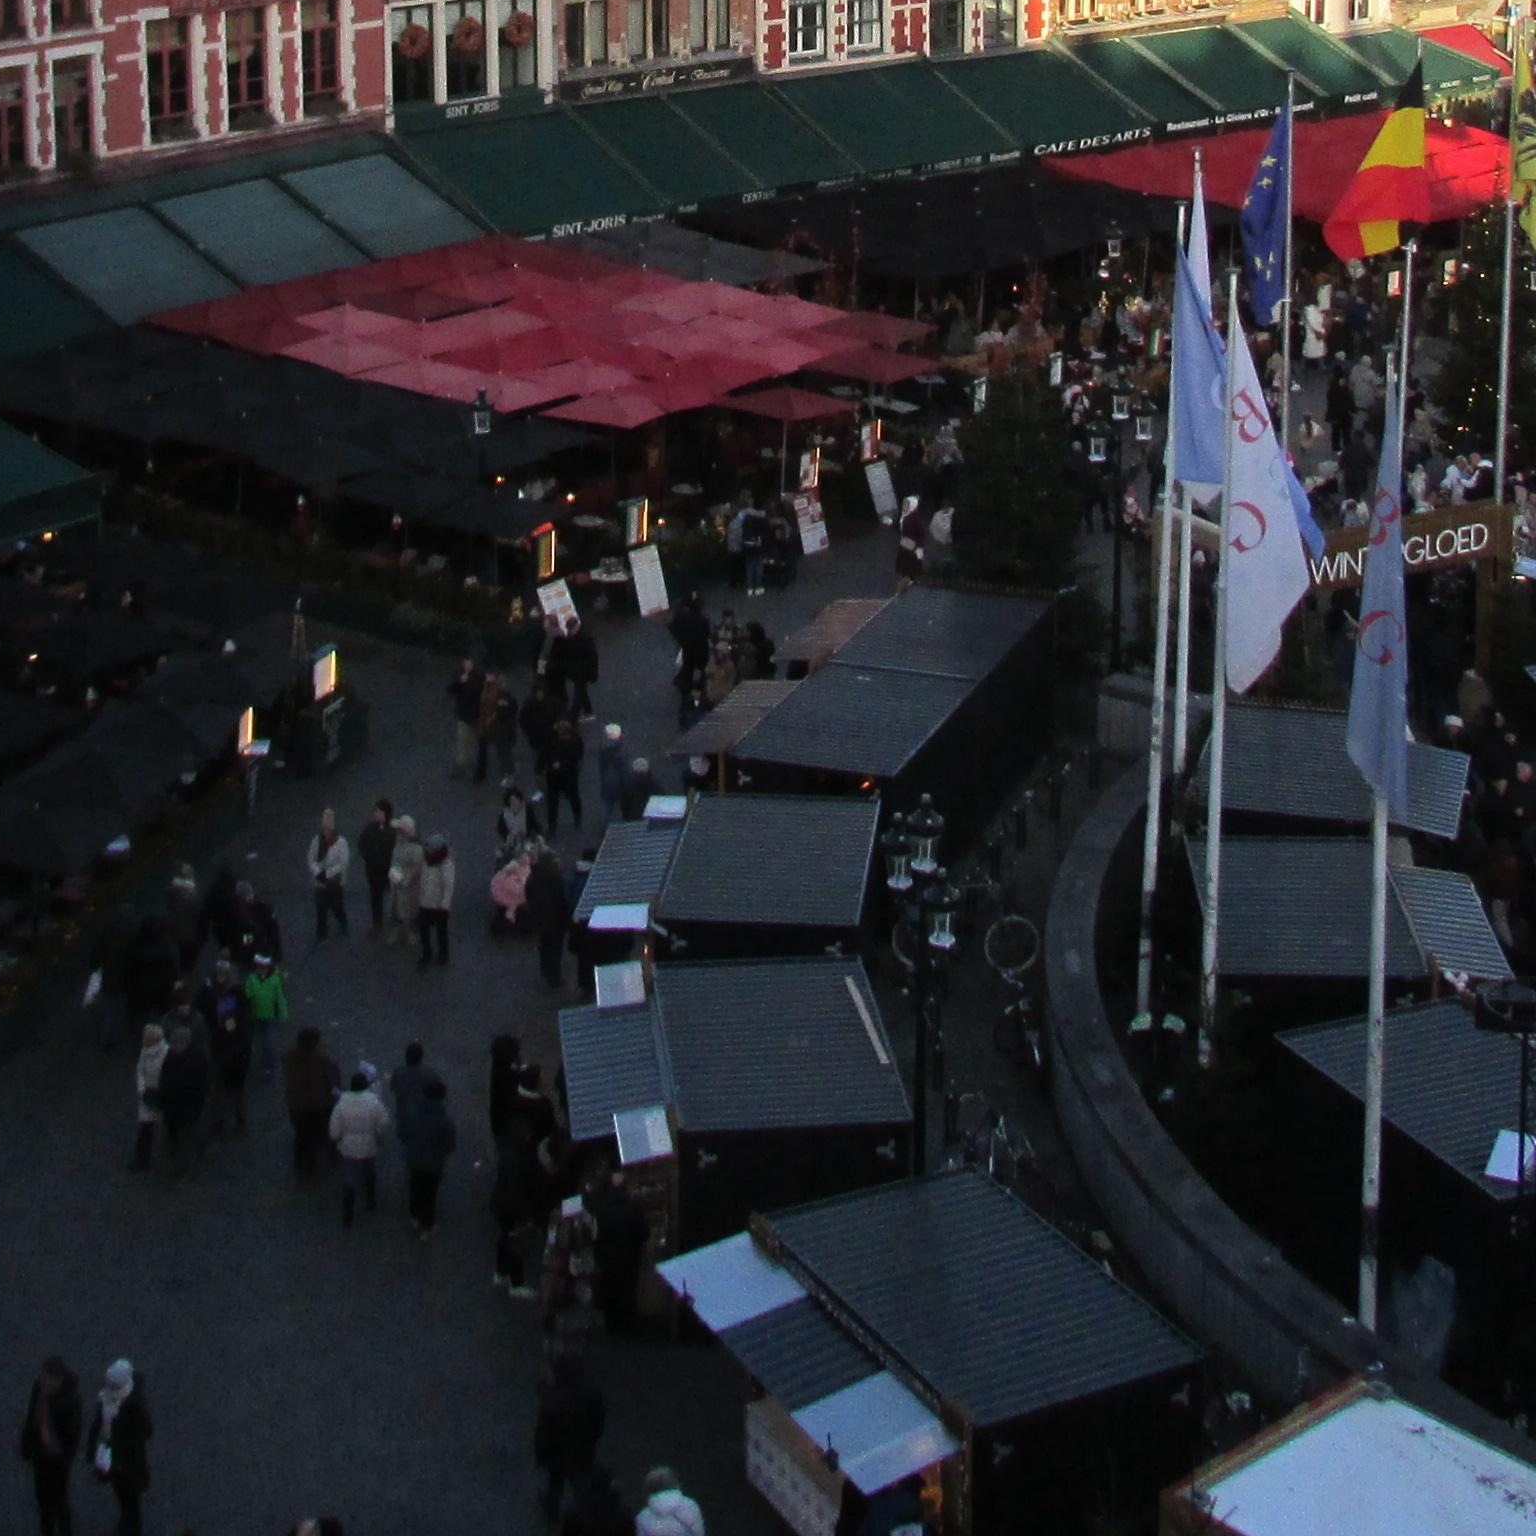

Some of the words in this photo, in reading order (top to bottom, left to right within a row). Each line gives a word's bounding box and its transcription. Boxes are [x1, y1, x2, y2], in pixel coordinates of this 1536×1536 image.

[445, 104, 469, 120] SINT
[471, 99, 501, 117] JORIS
[1033, 139, 1078, 157] CAFE
[1080, 133, 1112, 148] DES
[1112, 126, 1153, 143] ARTS
[552, 213, 627, 240] SINT-JORIS
[1310, 522, 1489, 586] WINGLOED
